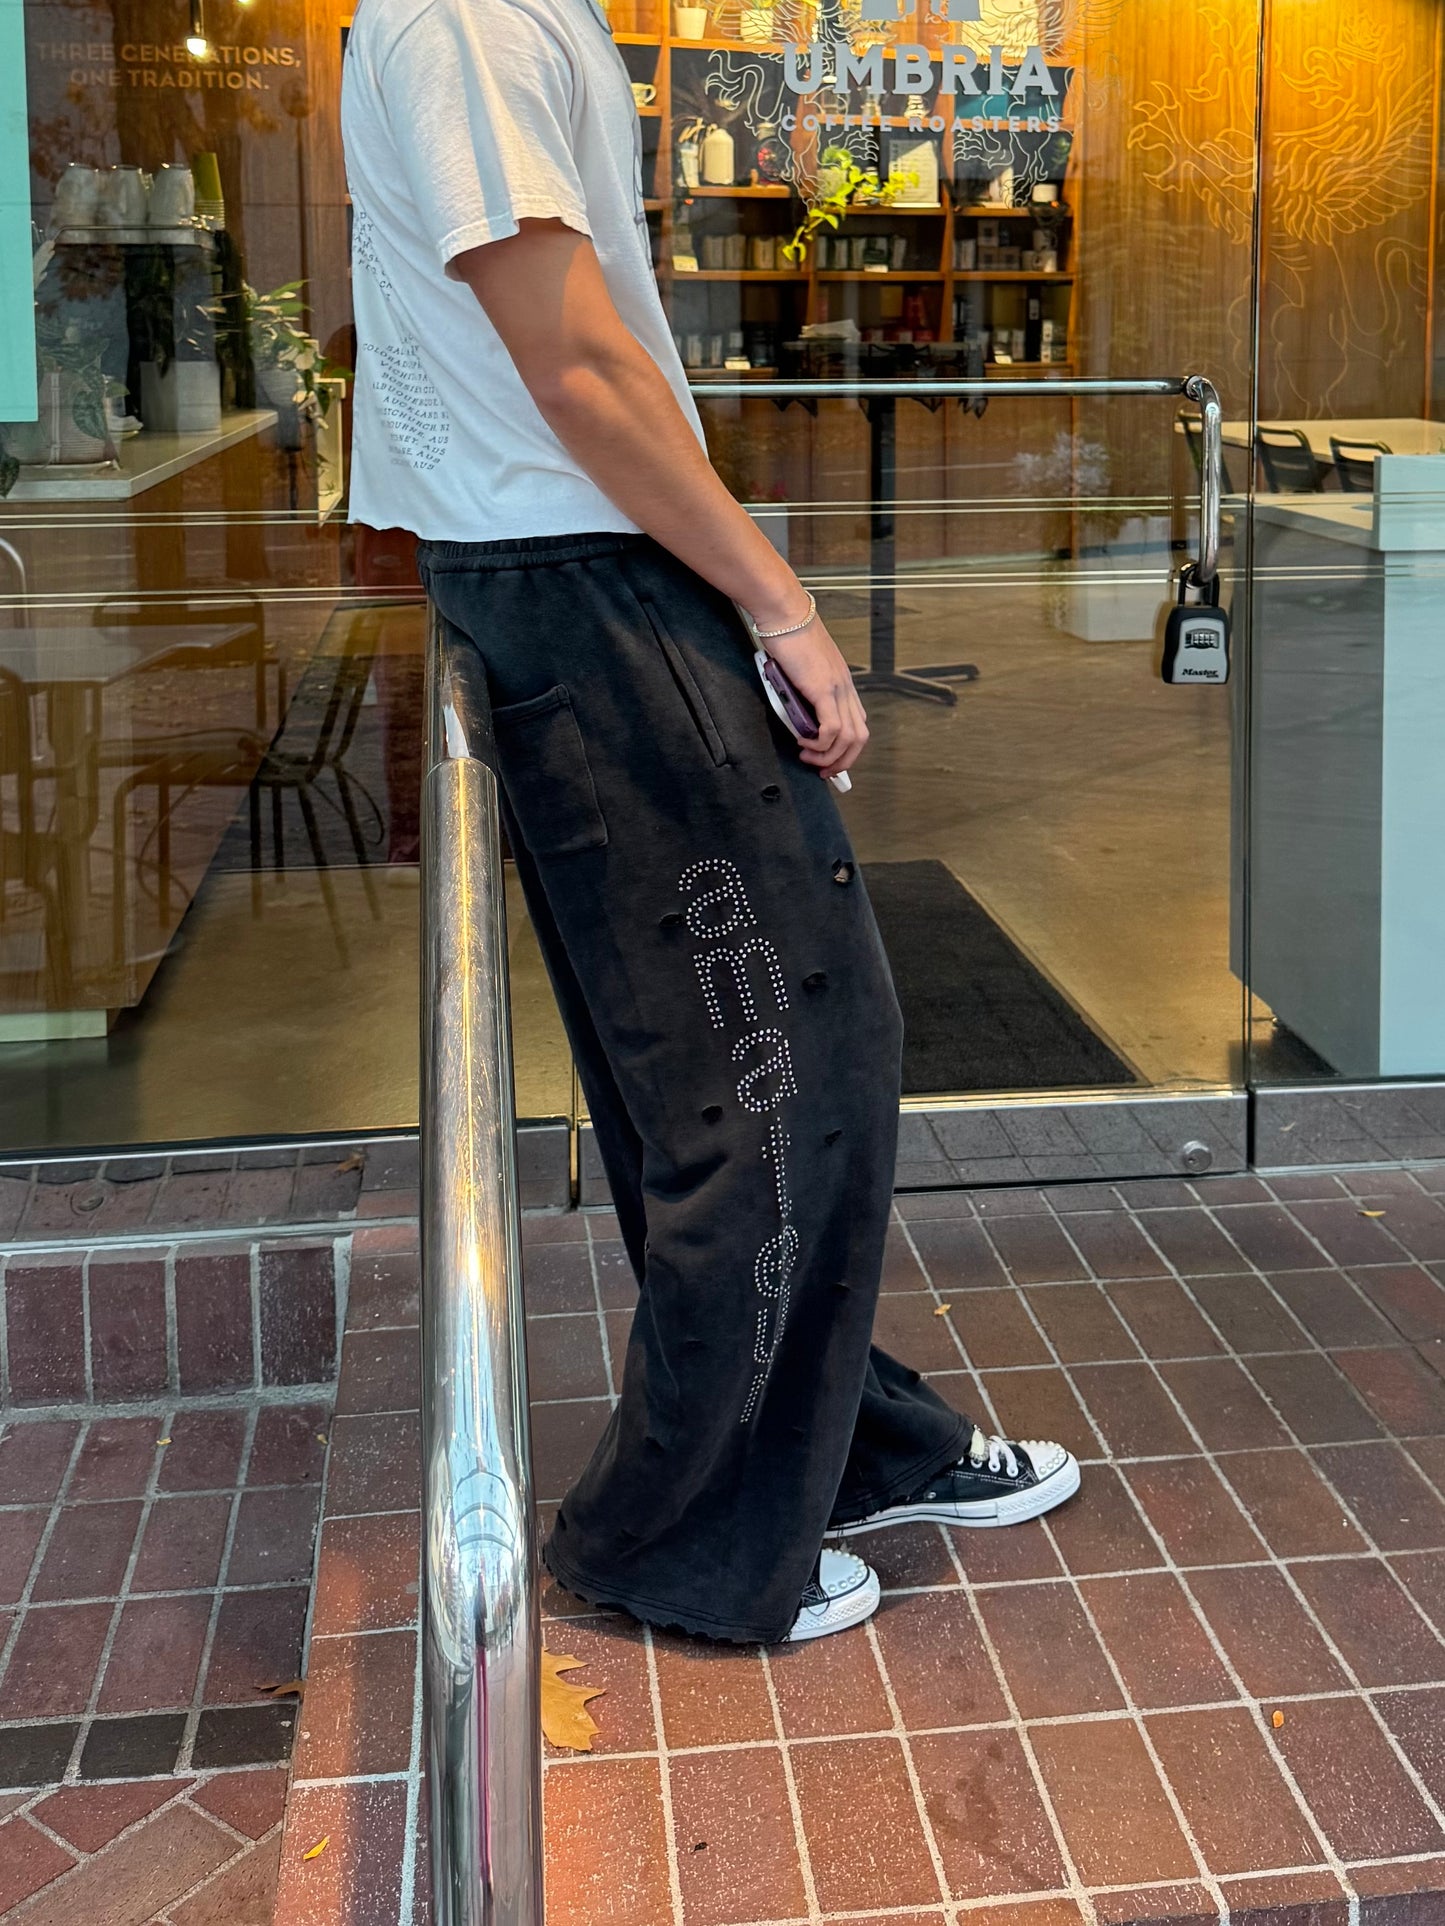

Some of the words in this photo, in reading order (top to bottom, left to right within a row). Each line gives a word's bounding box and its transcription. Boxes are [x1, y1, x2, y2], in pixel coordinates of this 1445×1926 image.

[37, 43, 115, 61] THREE
[120, 44, 302, 68] GENEATIONS,
[70, 68, 121, 87] ONE
[127, 69, 270, 90] TRADITION.
[783, 41, 1060, 96] UMBRIA
[781, 114, 893, 132] COFFEE
[908, 115, 1061, 133] ROASTERS
[1181, 668, 1219, 677] Master
